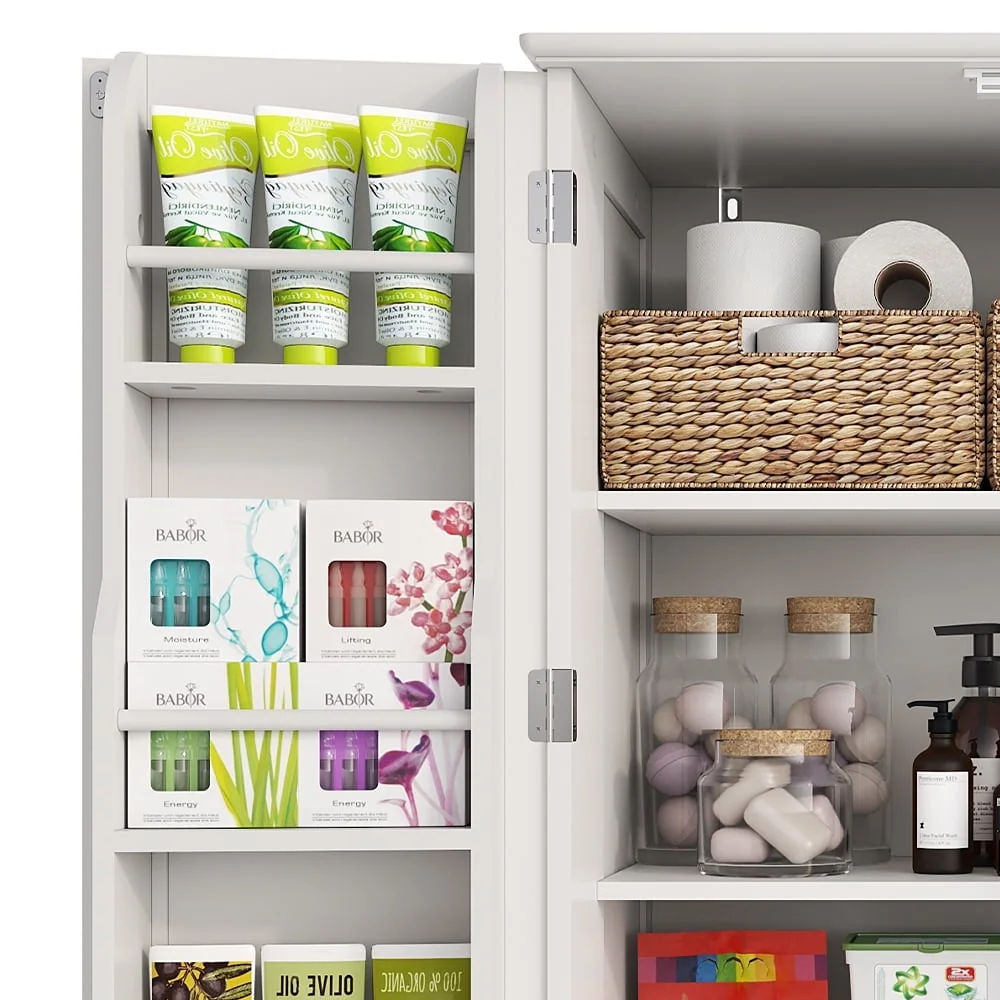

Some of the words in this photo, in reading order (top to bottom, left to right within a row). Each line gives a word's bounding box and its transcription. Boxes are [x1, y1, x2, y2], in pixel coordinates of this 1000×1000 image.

[156, 529, 207, 544] BABOR
[333, 530, 383, 545] BABOR
[341, 637, 372, 645] Lifting
[156, 693, 206, 707] BABOR
[325, 693, 374, 707] BABOR
